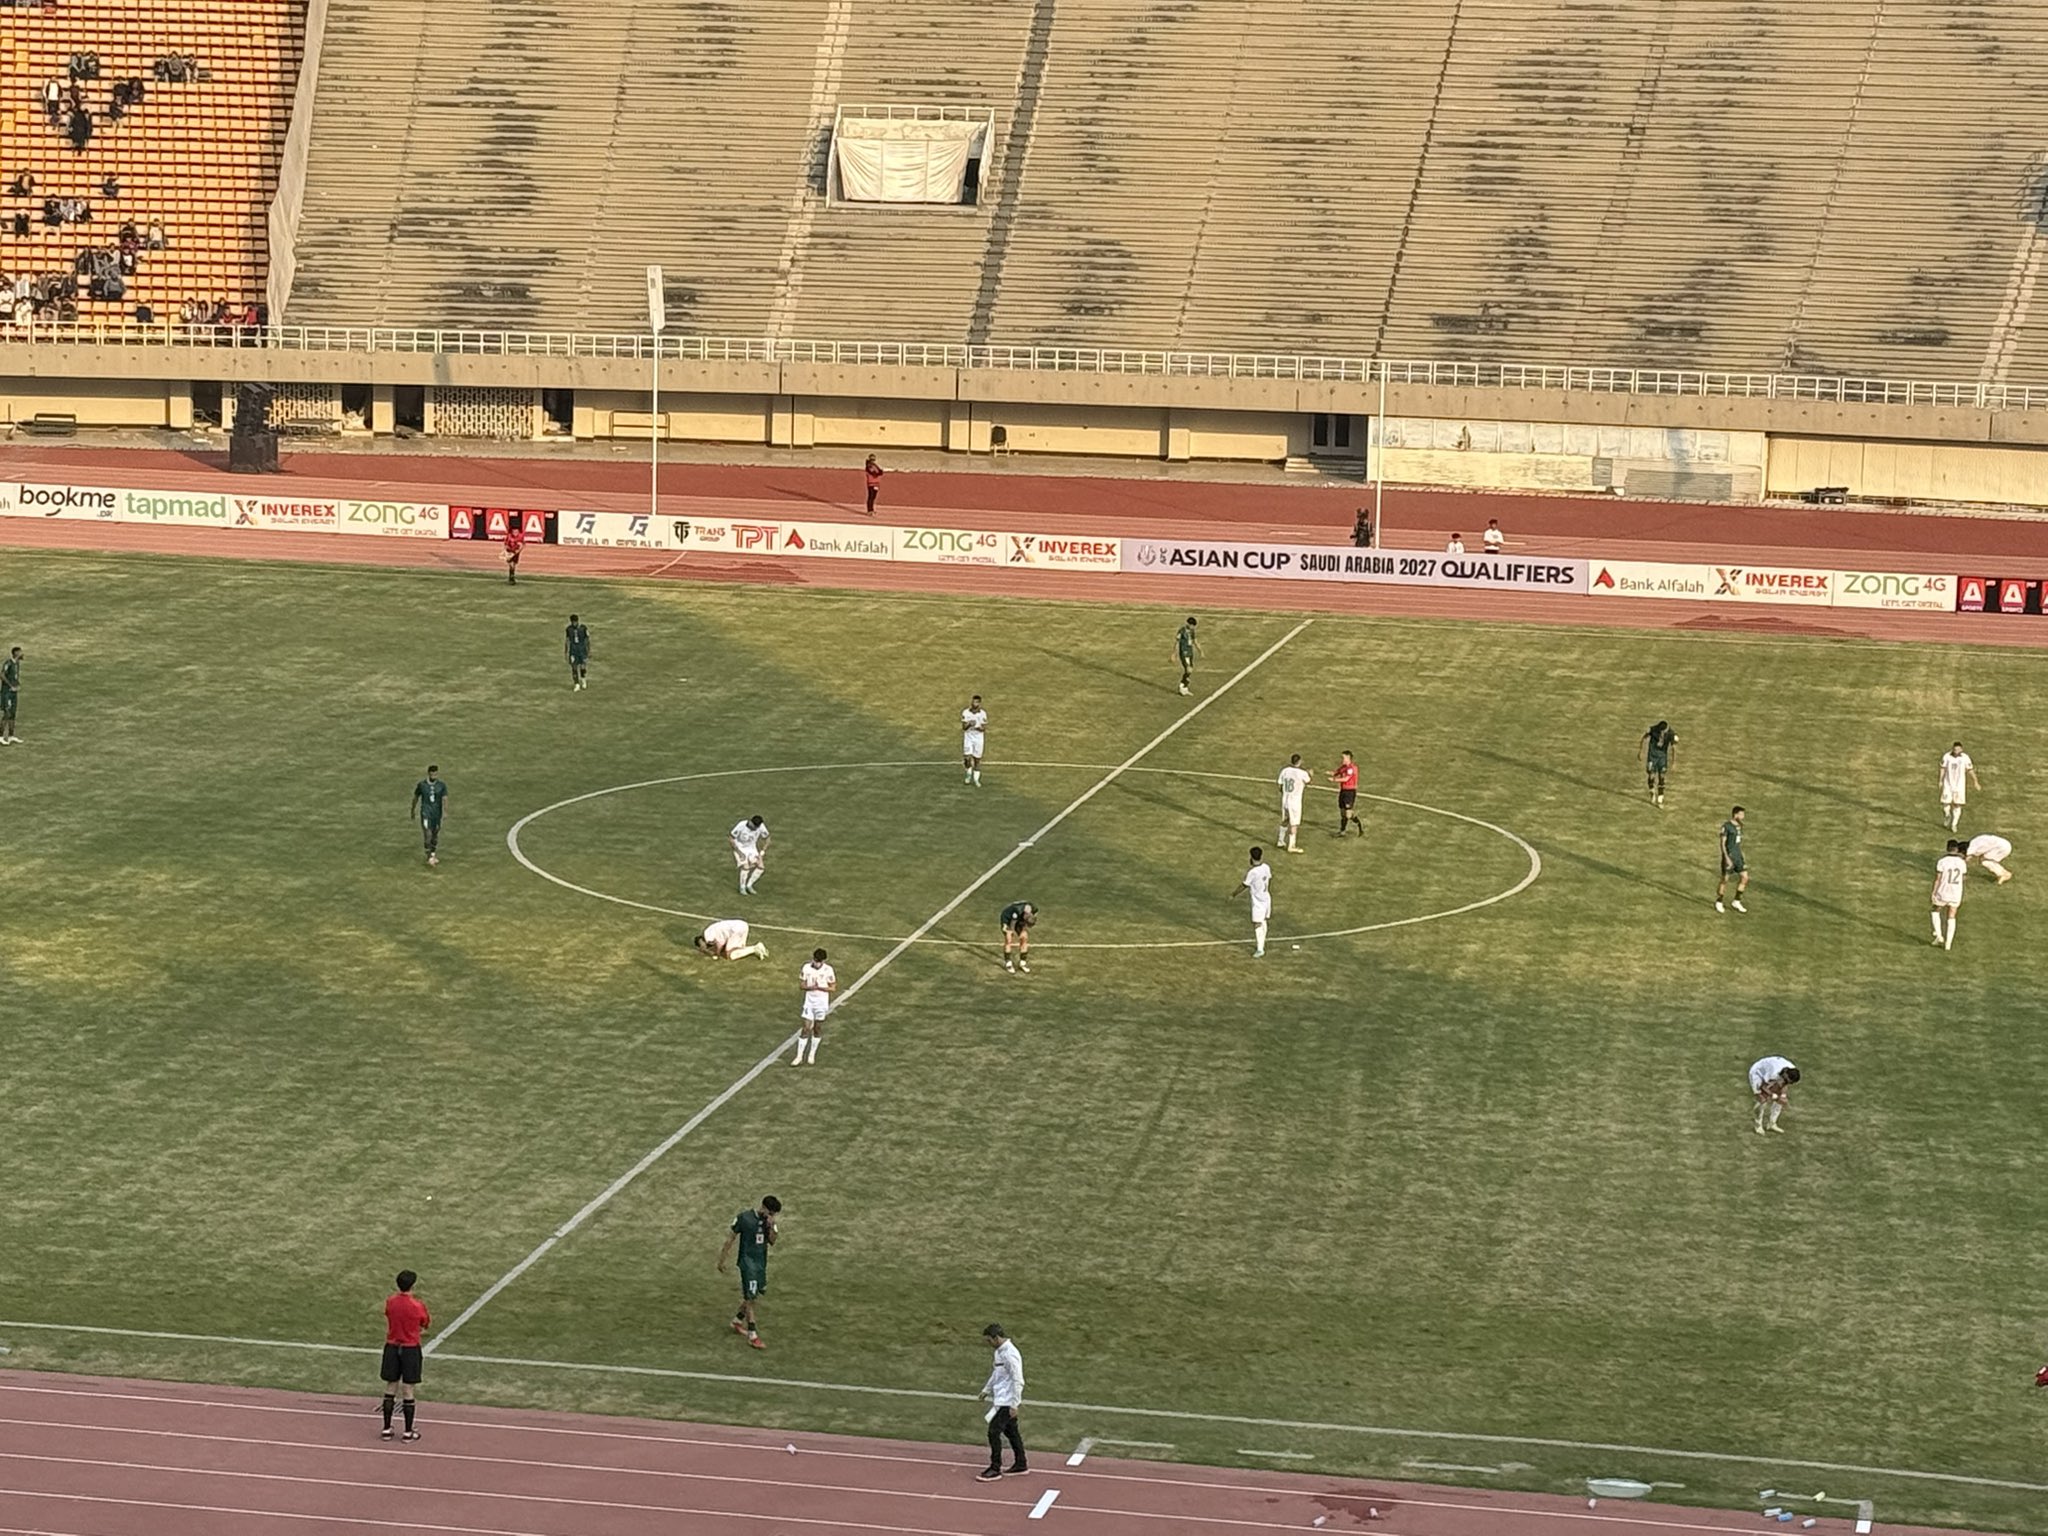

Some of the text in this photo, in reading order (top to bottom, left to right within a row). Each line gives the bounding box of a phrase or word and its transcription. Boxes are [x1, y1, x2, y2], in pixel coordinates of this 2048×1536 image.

[19, 485, 116, 508] bookme
[125, 493, 226, 519] tapmad
[261, 503, 336, 517] INVEREX
[418, 506, 440, 521] 4G
[694, 525, 726, 537] TRANS
[731, 524, 779, 550] TPT
[810, 539, 889, 555] Bank Alfalah
[976, 533, 998, 548] 4G
[1038, 540, 1118, 556] INVEREX
[1169, 548, 1575, 584] ASIAN CUP SAUDI ARABIA 2027 QUALIFIERS
[1620, 577, 1705, 594] Bank Alfalah
[1745, 573, 1828, 589] INVEREX
[1922, 577, 1947, 592] 4G
[1947, 868, 1961, 885] 12
